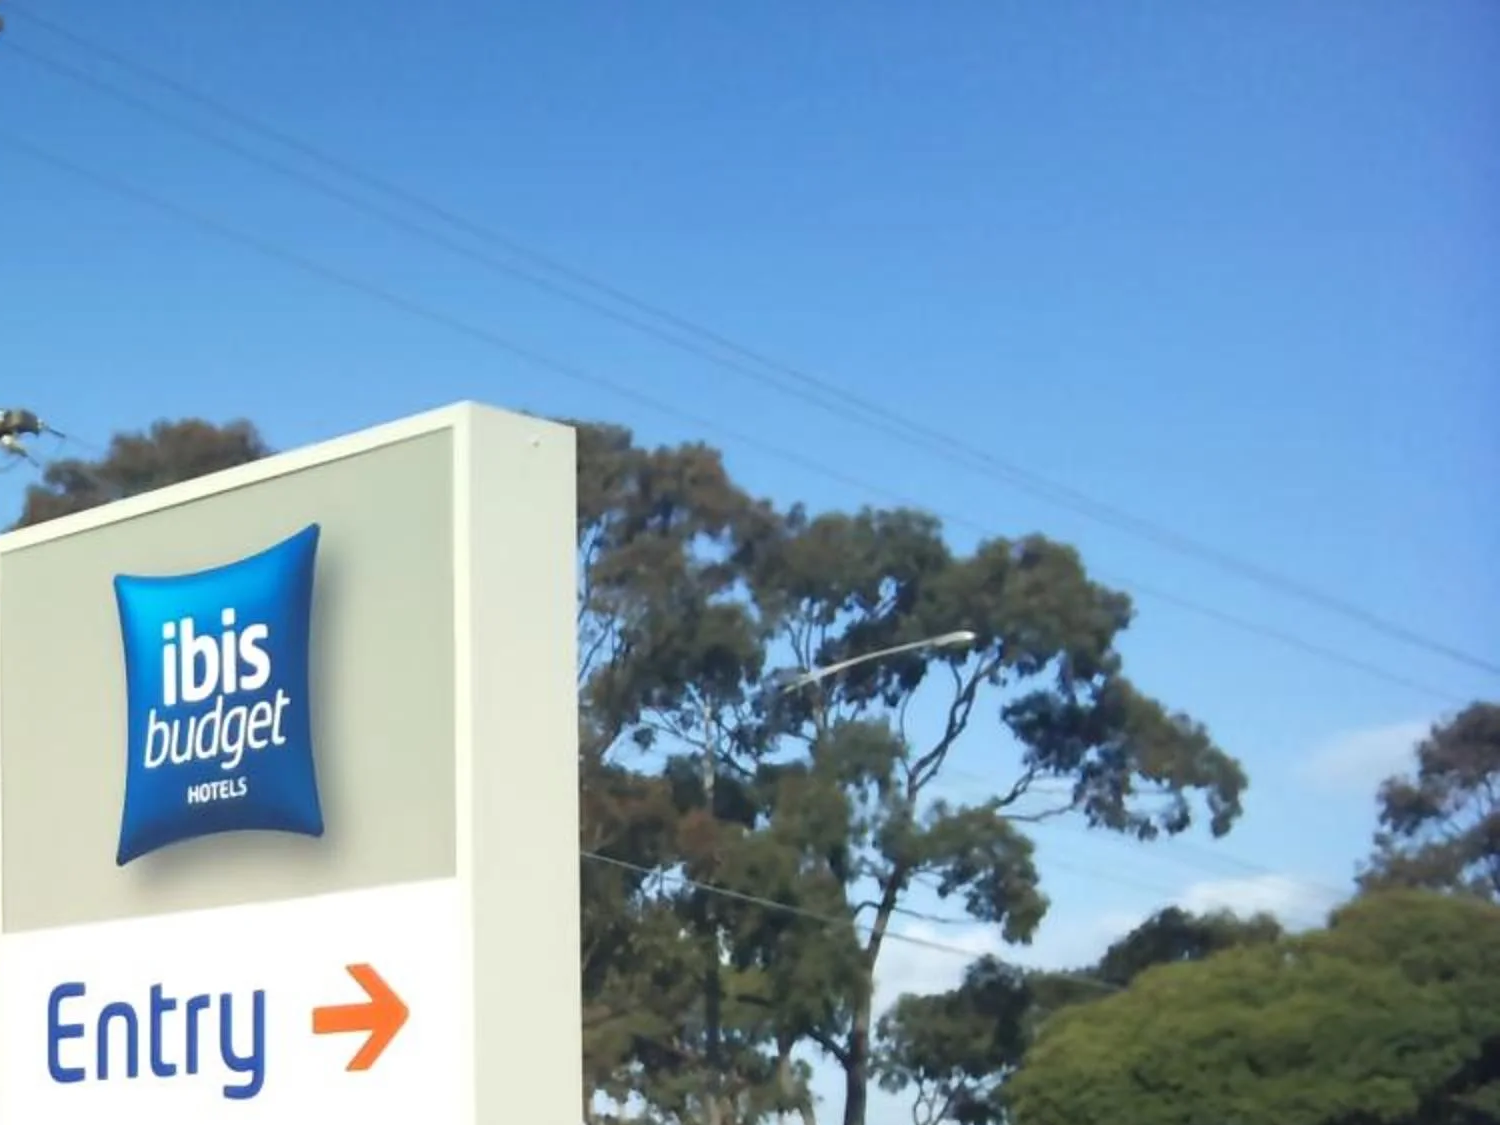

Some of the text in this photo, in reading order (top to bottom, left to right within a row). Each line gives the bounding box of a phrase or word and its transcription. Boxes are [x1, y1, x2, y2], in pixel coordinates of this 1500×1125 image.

[162, 608, 271, 706] ibis
[144, 688, 290, 769] budget
[187, 776, 248, 804] HOTELS
[48, 982, 265, 1099] Entry
